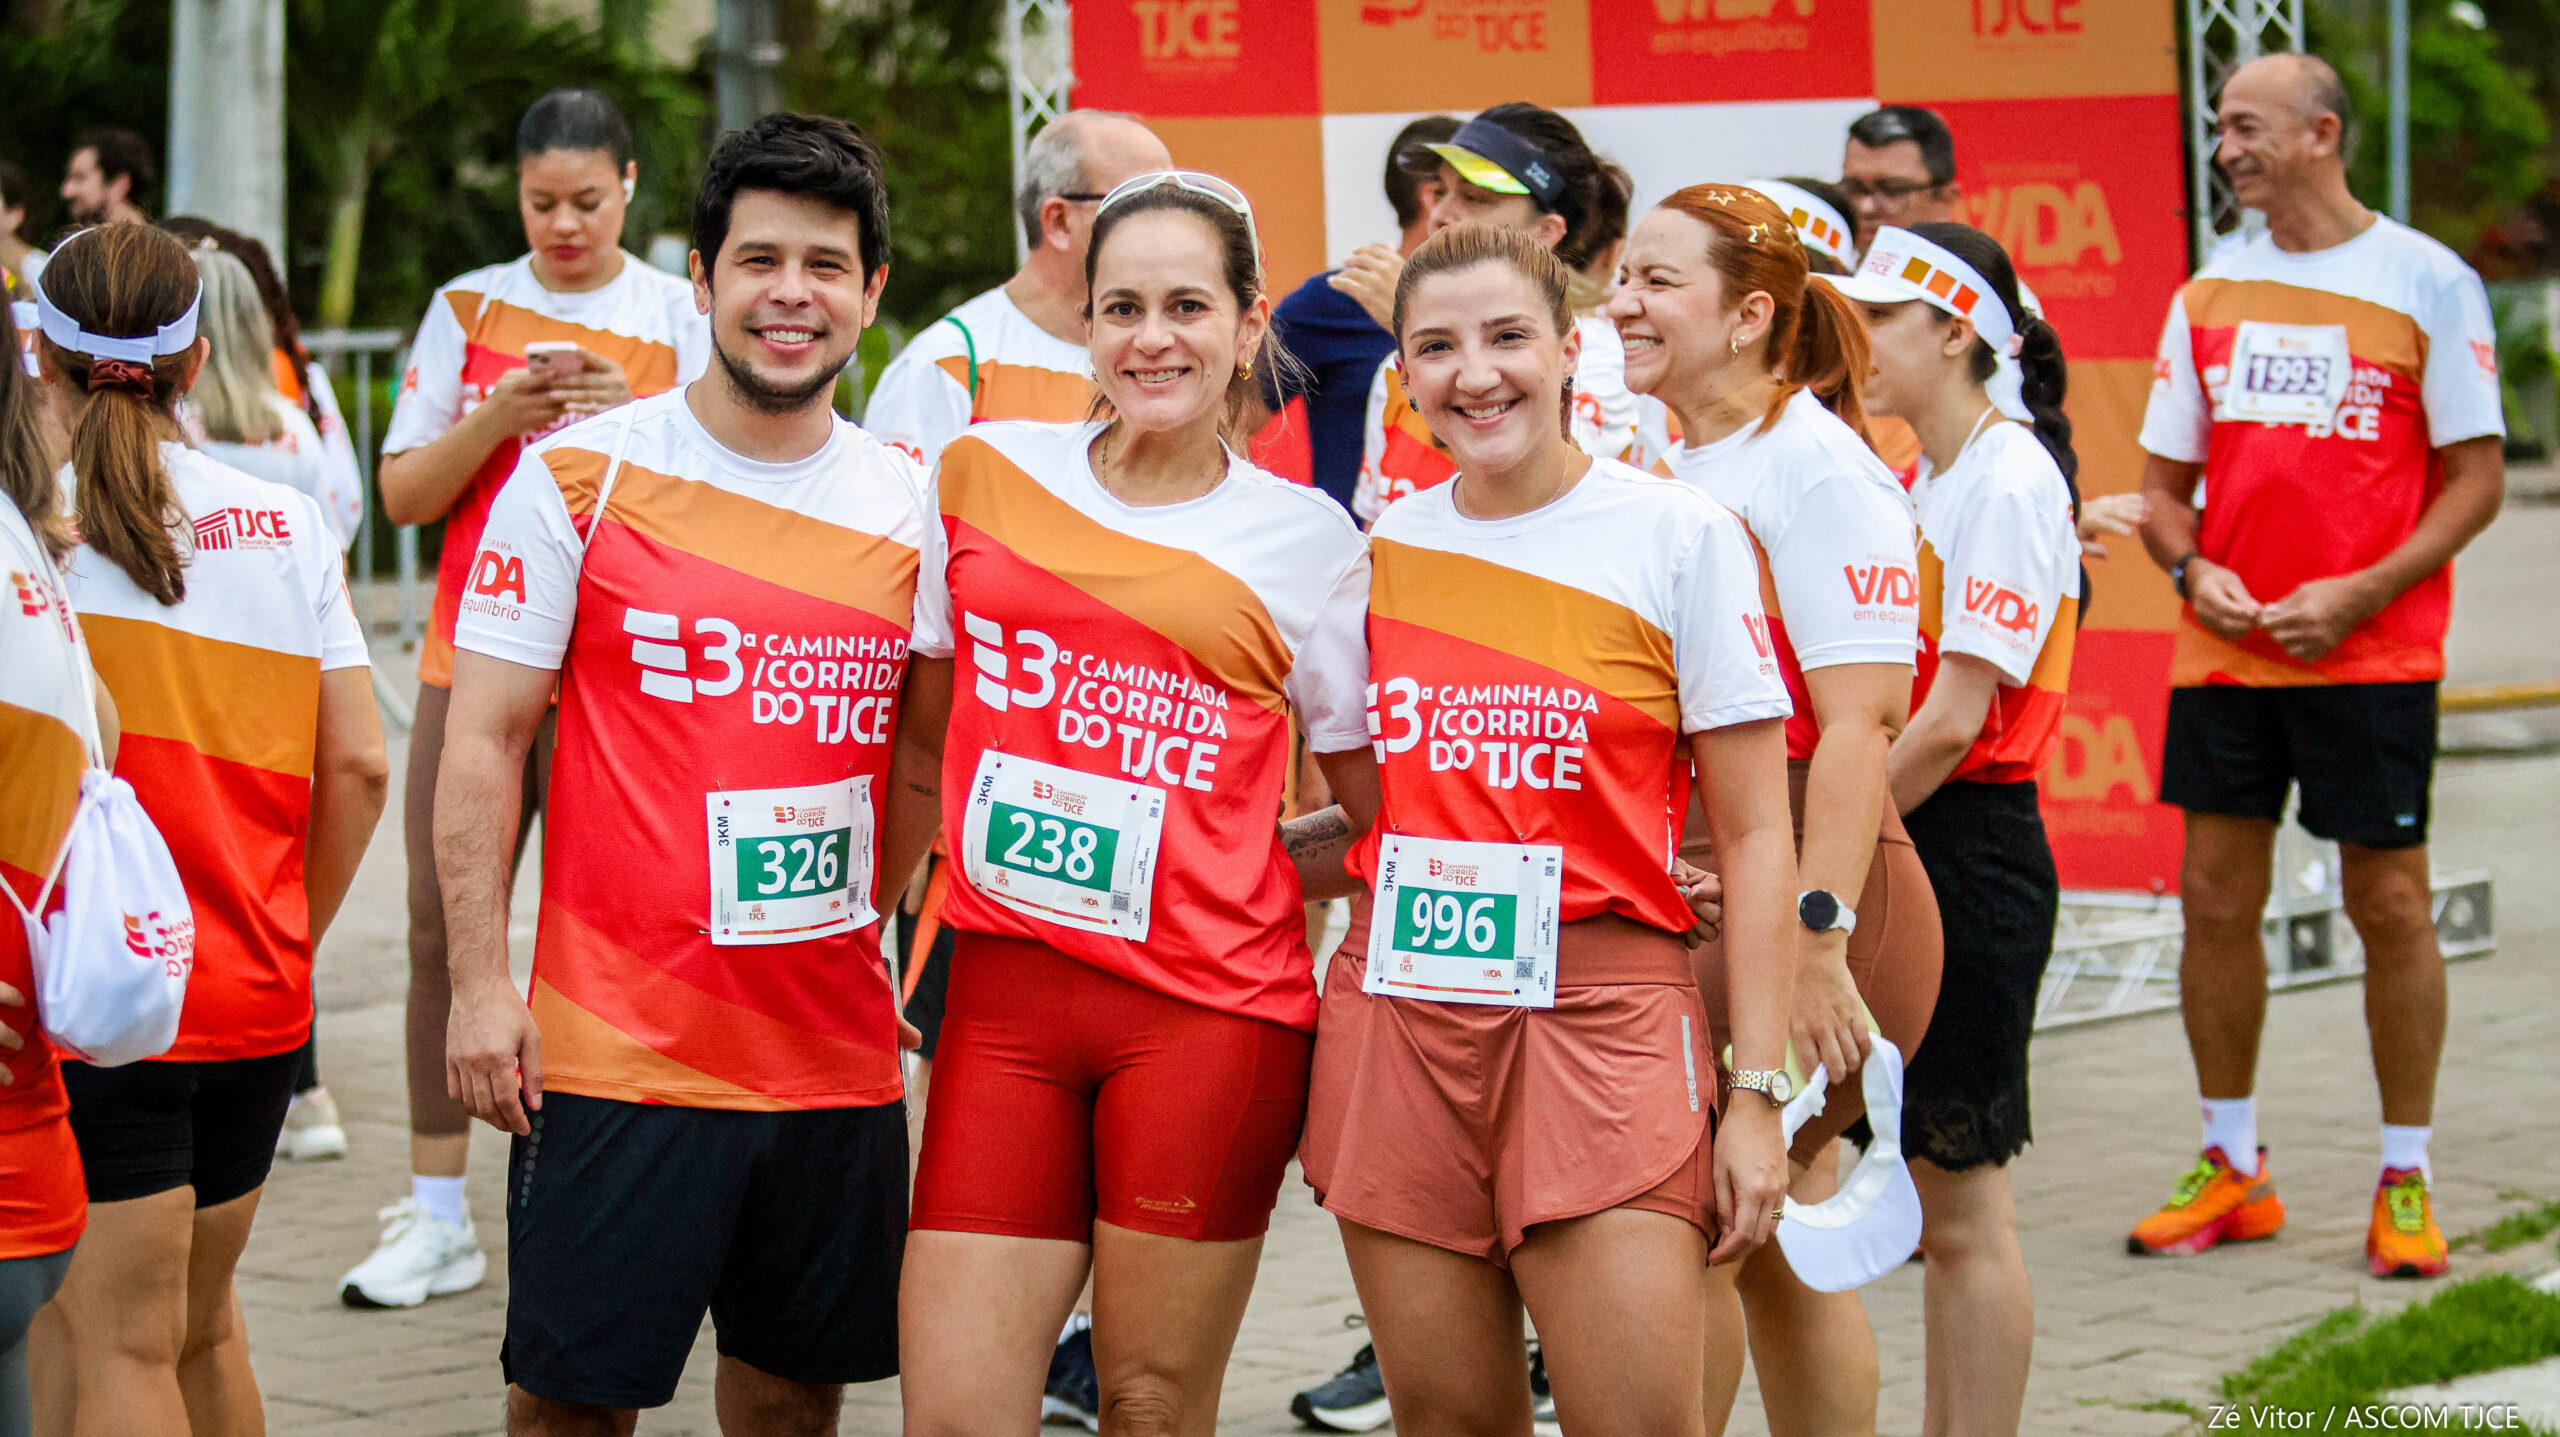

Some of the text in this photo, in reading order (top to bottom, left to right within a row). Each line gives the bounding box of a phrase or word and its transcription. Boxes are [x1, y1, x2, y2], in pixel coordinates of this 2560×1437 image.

[1132, 0, 1241, 58] TJCE
[2251, 356, 2330, 394] 1993
[227, 507, 291, 539] TJCE
[467, 550, 526, 604] IDA
[1854, 610, 1876, 621] em
[1966, 575, 2039, 643] VIDA
[763, 633, 910, 661] CAMINHADA
[1078, 654, 1229, 711] CAMINHADA
[1759, 663, 1774, 675] em
[1439, 684, 1599, 714] CAMINHADA
[752, 691, 893, 744] DO TJCE
[1057, 708, 1220, 792] DO TJCE
[1429, 738, 1583, 791] DO TJCE
[977, 775, 994, 806] 3KM
[807, 816, 825, 827] TJCE
[1063, 802, 1084, 815] TJCE
[717, 815, 730, 847] 3KM
[1003, 811, 1098, 881] 238
[757, 833, 838, 895] 326
[1384, 860, 1397, 892] 3KM
[994, 876, 1010, 887] TJCE
[1454, 875, 1477, 886] TJCE
[748, 912, 766, 921] TJCE
[1411, 892, 1497, 953] 996
[1399, 963, 1413, 973] TJCE
